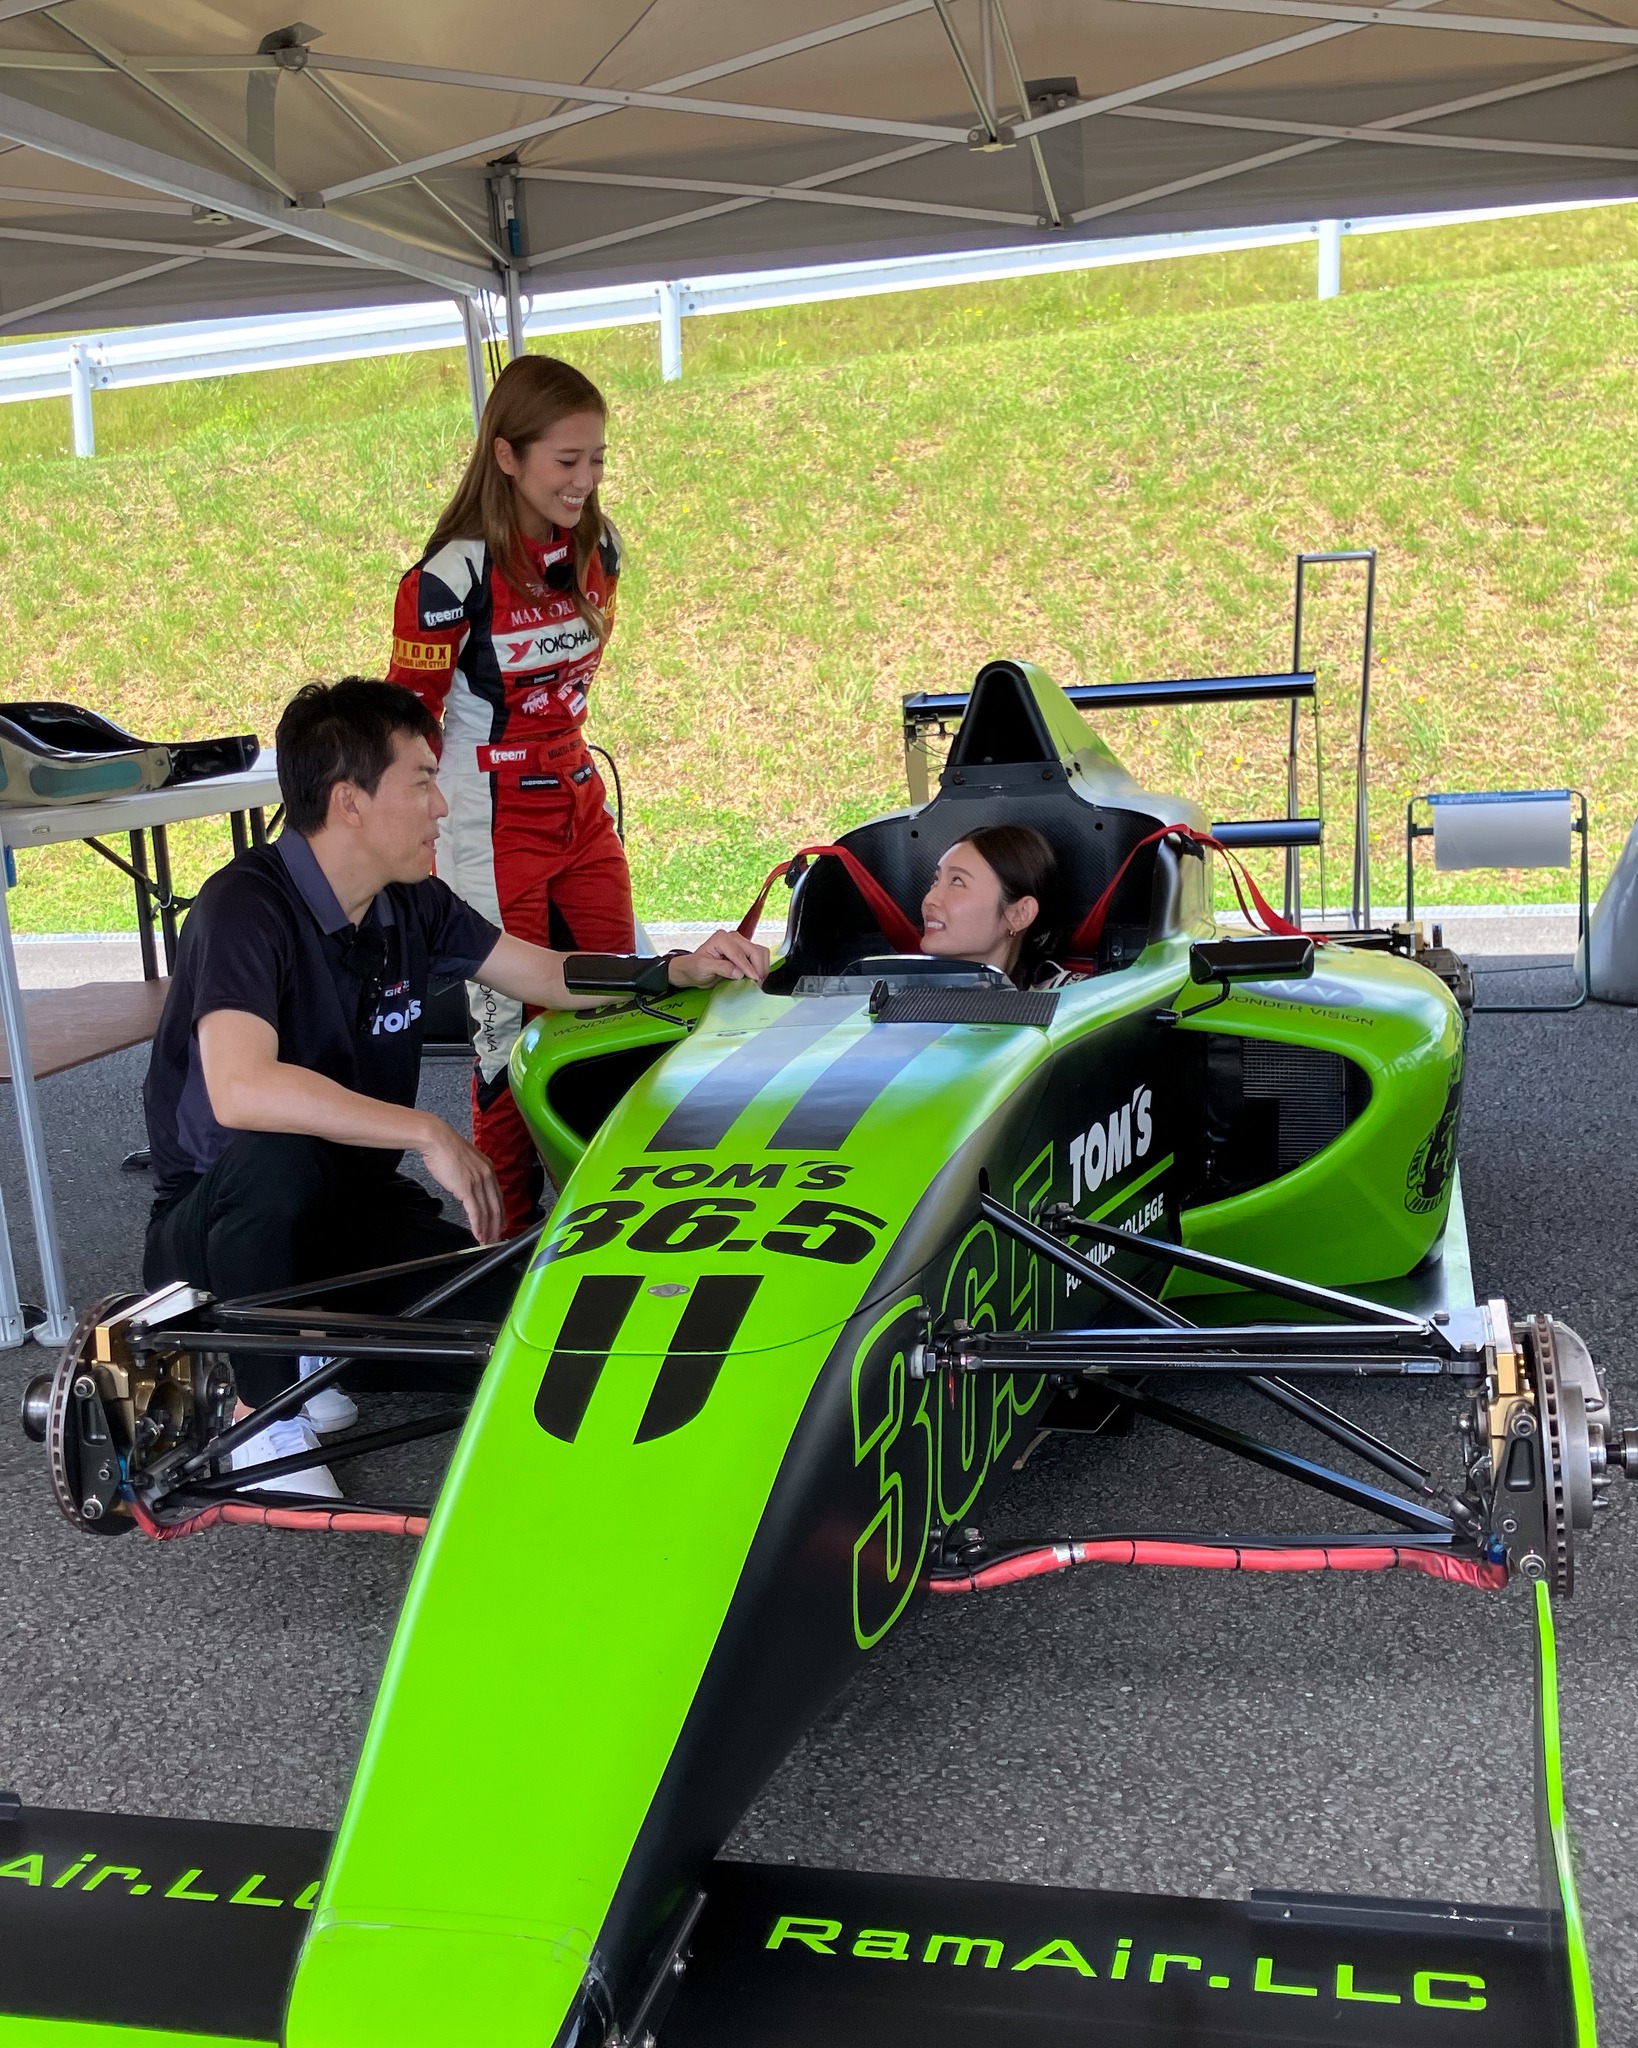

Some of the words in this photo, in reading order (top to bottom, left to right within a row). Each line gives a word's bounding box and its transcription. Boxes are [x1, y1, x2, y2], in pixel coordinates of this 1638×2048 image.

[511, 607, 544, 627] MAX
[480, 984, 498, 1053] OKOHAMA
[553, 1014, 624, 1037] WONDER
[1310, 1007, 1374, 1026] VISION
[1069, 1083, 1153, 1207] TOM'S
[610, 1160, 855, 1192] TOM'S
[528, 1197, 889, 1274] 36.5
[765, 1915, 1488, 2012] RamAir.LLC
